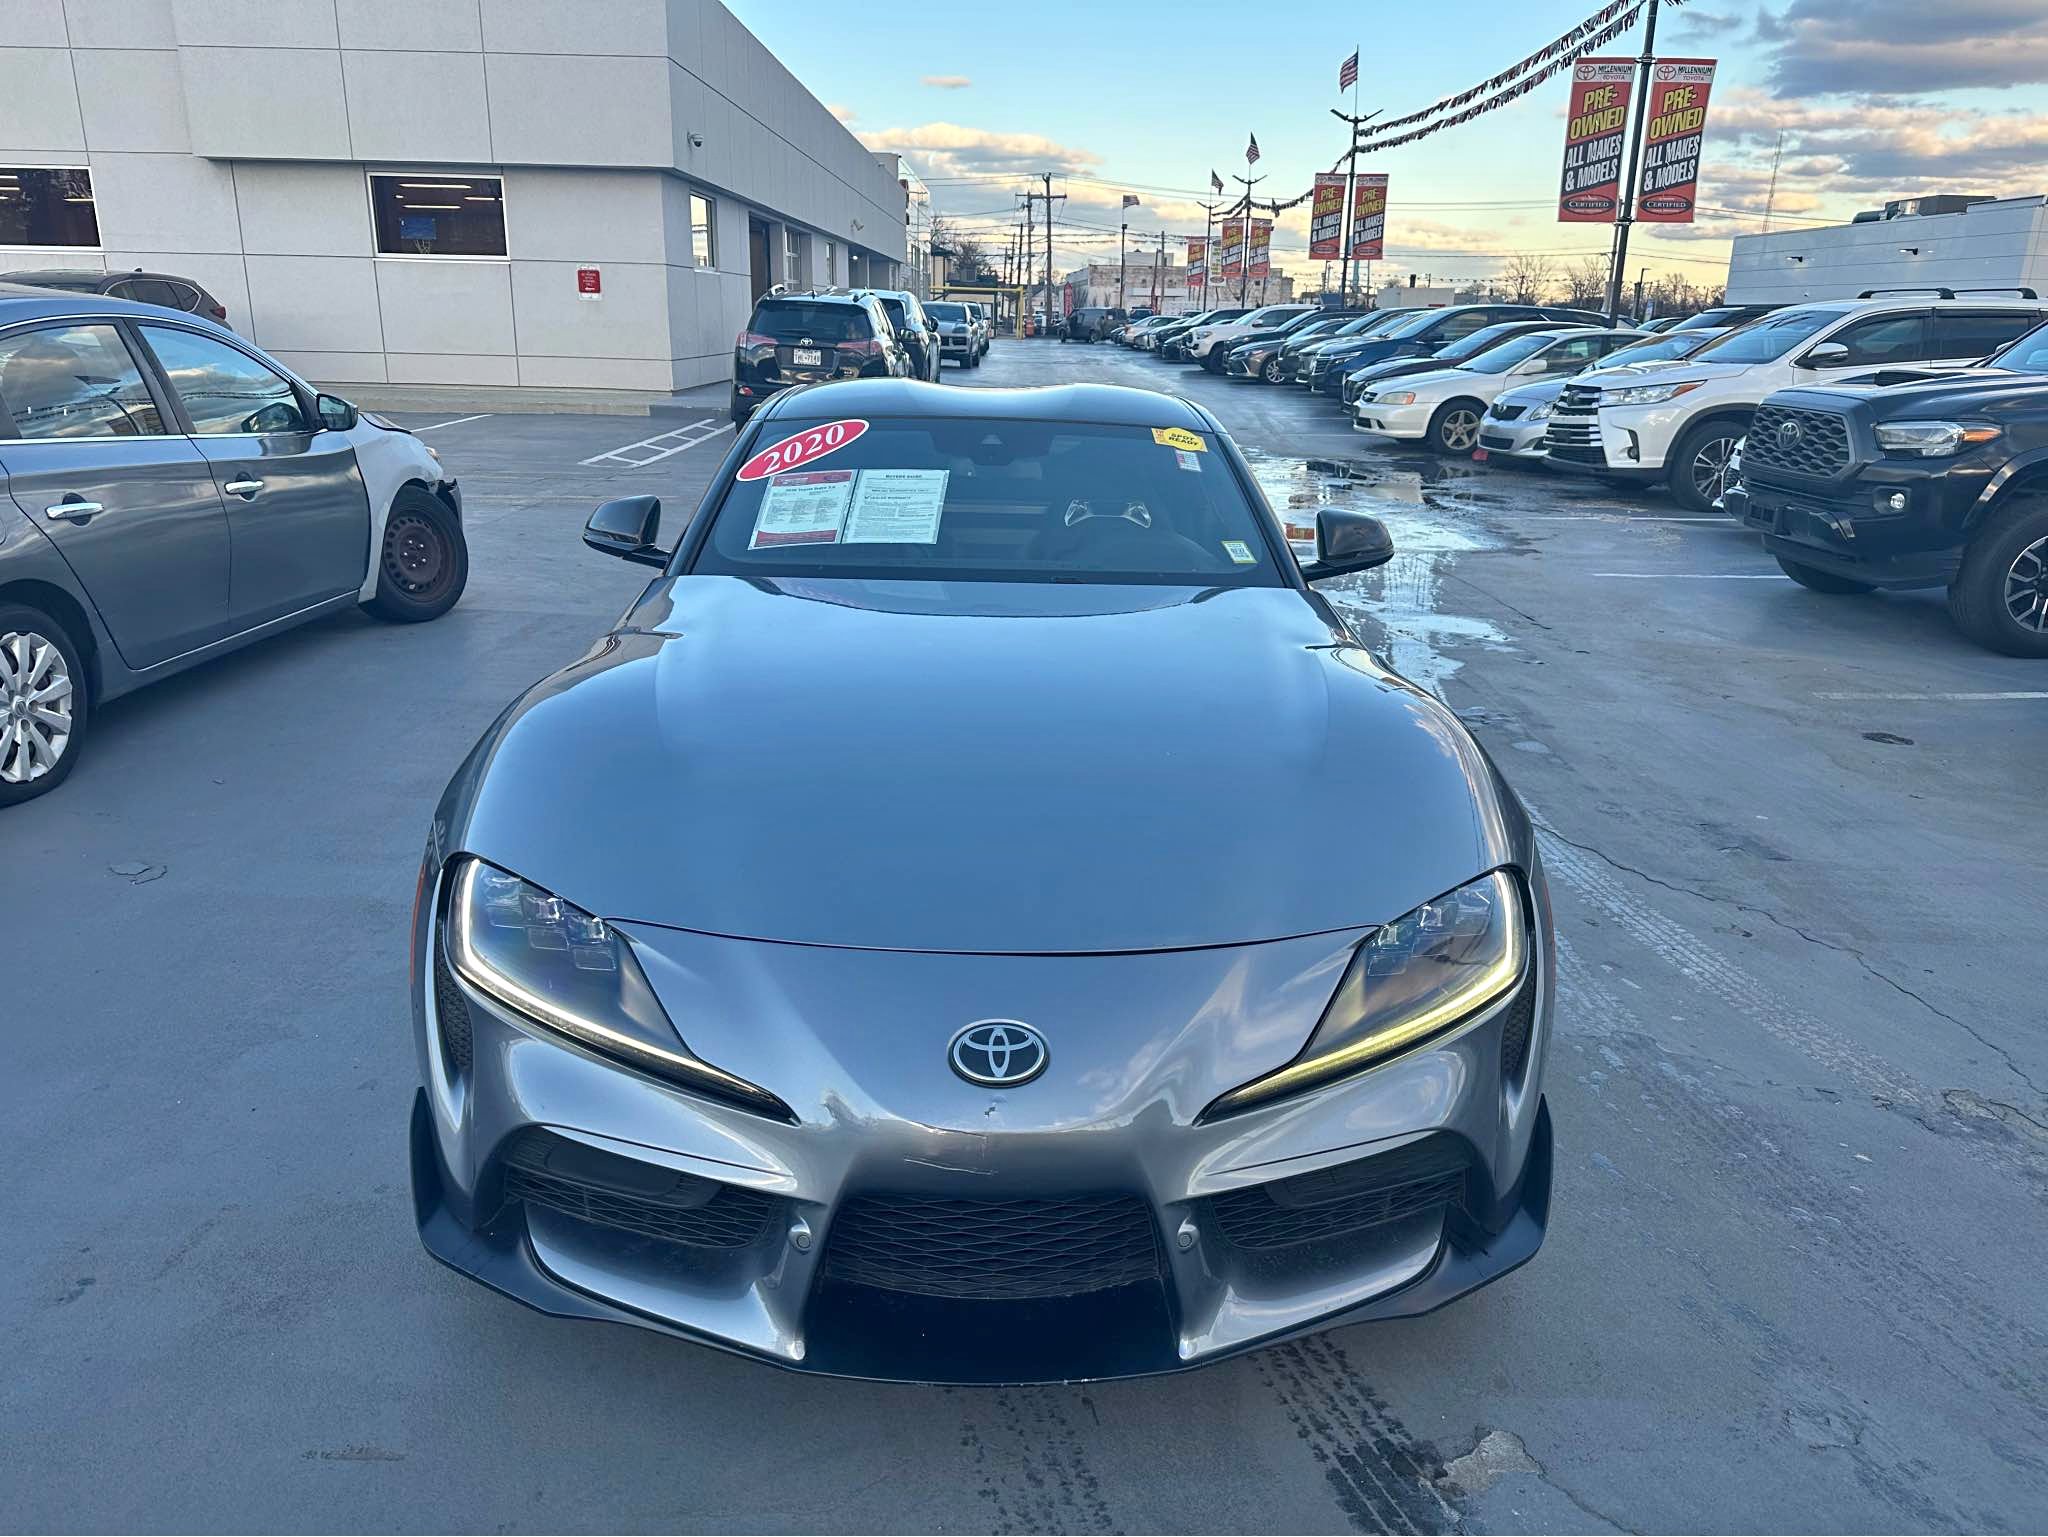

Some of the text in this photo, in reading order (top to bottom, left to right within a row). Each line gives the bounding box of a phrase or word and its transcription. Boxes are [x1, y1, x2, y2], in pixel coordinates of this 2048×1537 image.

[1598, 65, 1632, 74] MILLENNIUM
[1677, 66, 1713, 75] MILLENNIUM
[1583, 84, 1618, 114] PRE-
[1662, 84, 1698, 114] PRE-
[1570, 106, 1625, 139] OWNED
[1649, 106, 1704, 140] OWNED
[1565, 134, 1622, 169] ALL MAKES
[1644, 134, 1700, 169] ALL MAKES
[1565, 158, 1618, 191] & MODELS
[1643, 158, 1695, 191] & MODELS
[1314, 198, 1342, 214] OWNED
[1356, 199, 1385, 217] OWNED
[1646, 200, 1686, 208] CERTIFIED
[763, 424, 845, 475] 2020
[1168, 436, 1198, 446] READY
[1171, 433, 1195, 441] SPOT
